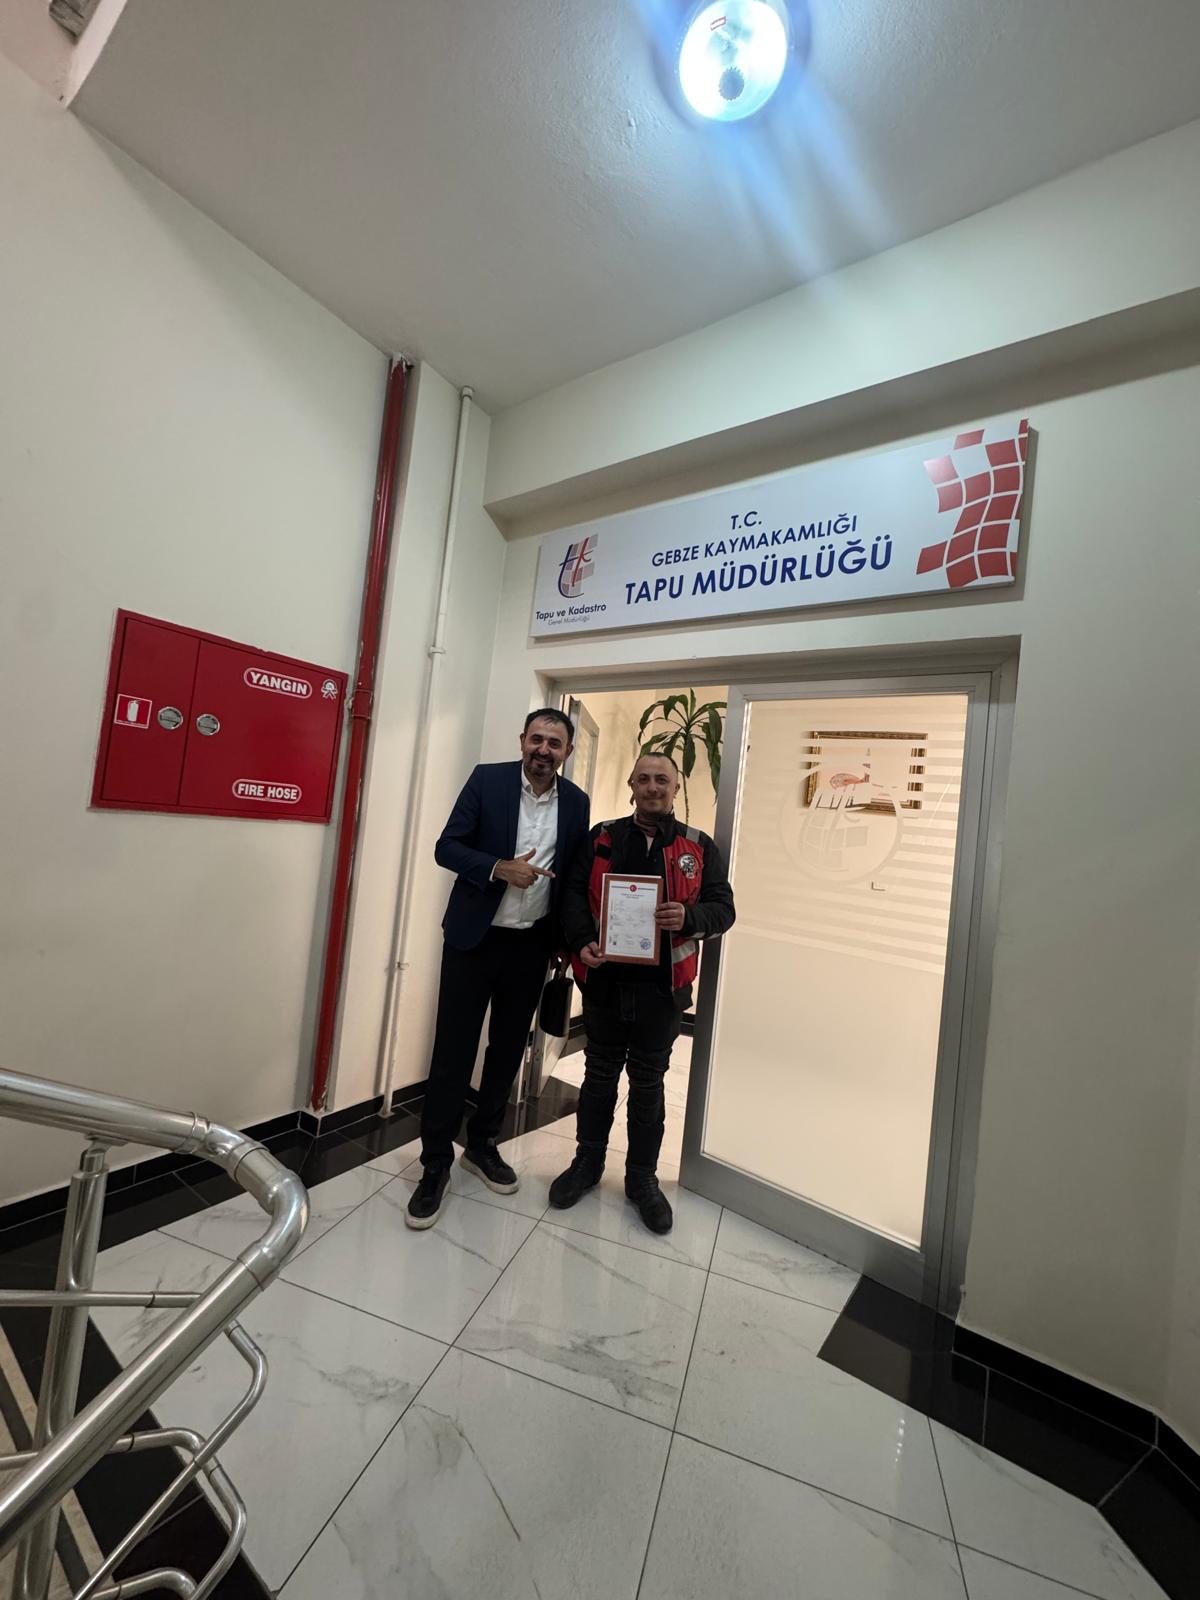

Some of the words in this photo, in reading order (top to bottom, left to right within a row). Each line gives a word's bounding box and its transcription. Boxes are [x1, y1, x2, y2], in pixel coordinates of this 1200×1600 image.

[730, 511, 762, 530] T.C.
[652, 545, 699, 567] GEBZE
[704, 513, 858, 558] KAYMAKAMLIĞI
[625, 575, 684, 605] TAPU
[691, 534, 893, 596] MÜDÜRLÜĞÜ
[536, 611, 555, 621] Tapu
[556, 609, 566, 617] ve
[568, 604, 607, 616] Kadastro
[250, 671, 307, 695] YANGIN
[237, 783, 265, 797] FIRE
[267, 786, 298, 800] HOSE
